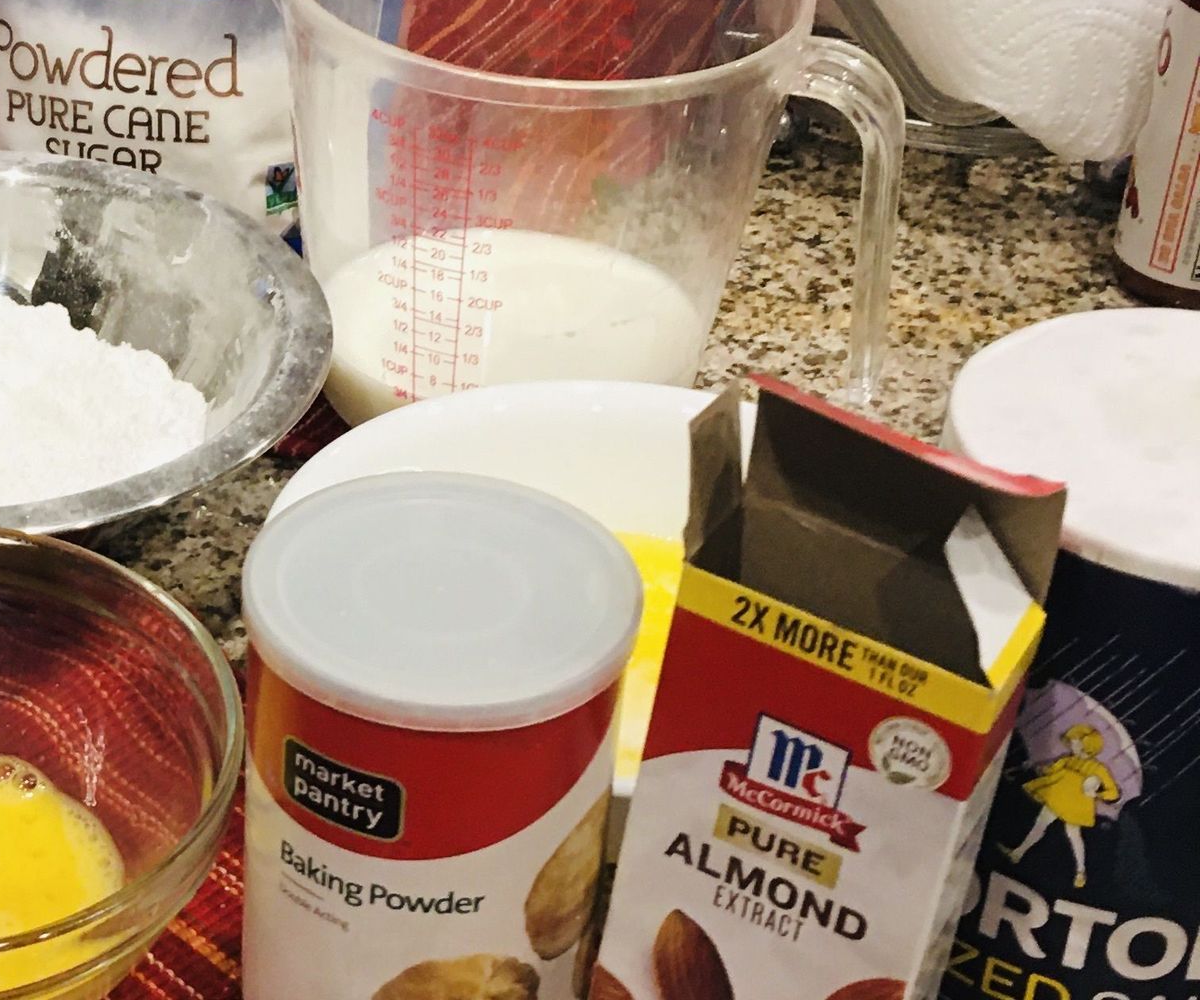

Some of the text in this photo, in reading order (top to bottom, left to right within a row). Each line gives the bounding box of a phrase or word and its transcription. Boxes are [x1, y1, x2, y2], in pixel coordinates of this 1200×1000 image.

[6, 88, 210, 144] PURE CANE
[430, 247, 446, 261] 20
[467, 296, 504, 312] 2CUP
[428, 331, 442, 344] 12
[730, 596, 858, 672] 2X MORE
[862, 647, 897, 671] THAN
[293, 776, 383, 829] pantry
[295, 753, 384, 802] market
[726, 771, 846, 836] McCormick
[726, 816, 826, 876] PURE
[280, 839, 486, 915] Baking Powder
[664, 832, 868, 941] ALMOND
[712, 884, 804, 942] EXTRACT
[964, 869, 1200, 981] RTO
[947, 938, 1072, 1000] ZED
